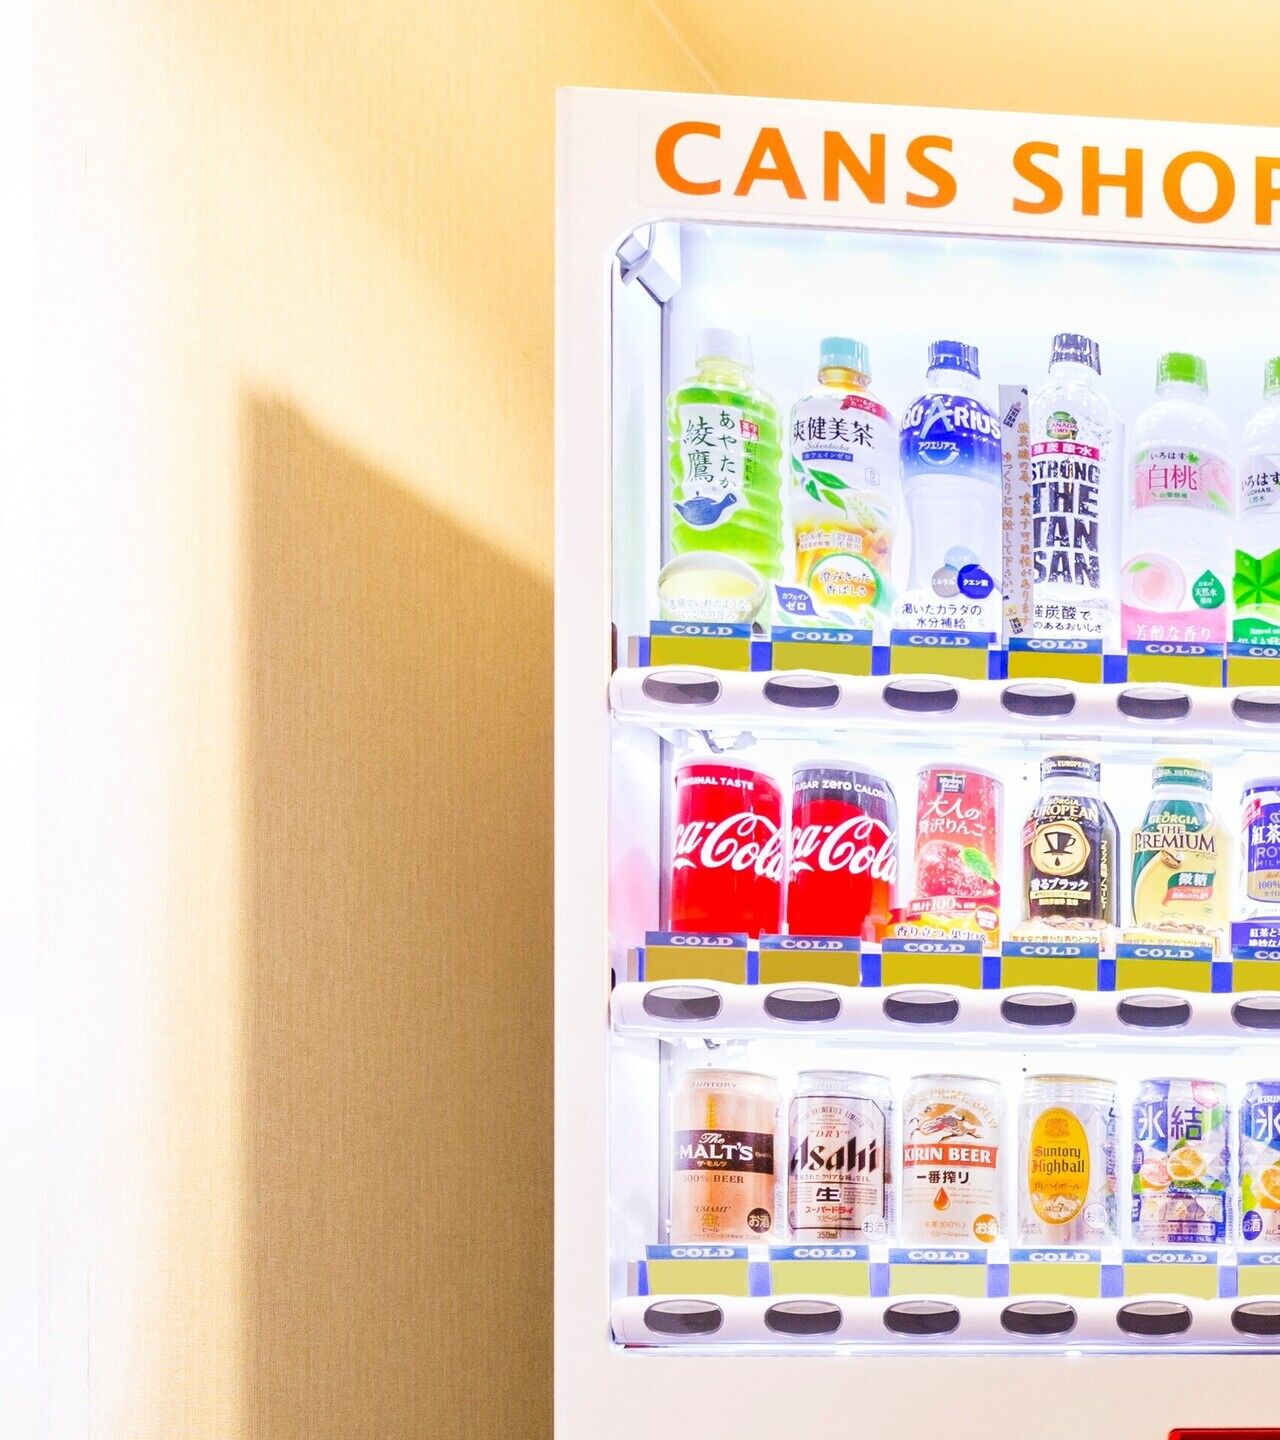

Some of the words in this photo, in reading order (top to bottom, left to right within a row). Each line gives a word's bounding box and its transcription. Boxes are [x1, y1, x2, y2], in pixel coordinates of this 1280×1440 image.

[655, 120, 958, 209] CANS
[683, 416, 716, 483] 綾鷹
[718, 410, 737, 489] あやたか
[918, 441, 960, 451] アクエリアス
[1151, 452, 1186, 460] いろはす
[1031, 458, 1100, 484] STRONG
[1148, 464, 1199, 491] 白桃
[1032, 481, 1099, 518] THE
[1033, 516, 1099, 552] TAN
[1034, 551, 1100, 589] SAN
[781, 592, 809, 601] カフェイン
[1195, 587, 1218, 597] 天然水
[785, 600, 808, 611] ゼロ
[916, 616, 967, 630] 水分補給
[670, 625, 734, 636] COLD
[791, 631, 854, 642] COLD
[1136, 623, 1212, 643] 芳醇な香り
[909, 635, 970, 646] COLD
[1026, 639, 1088, 650] COLD
[1145, 644, 1206, 654] COLD
[720, 777, 755, 791] TASTE
[821, 779, 853, 791] zero
[926, 798, 982, 820] 大人の
[1150, 812, 1200, 825] GEORGIA
[1159, 825, 1184, 835] THE
[1135, 833, 1216, 852] PREMIUM
[1030, 878, 1089, 891] 香るブラック
[1178, 872, 1208, 887] 微糖
[670, 935, 734, 946] COLD
[780, 939, 844, 950] COLD
[903, 942, 966, 952] COLD
[1020, 945, 1081, 955] COLD
[1134, 948, 1195, 958] COLD
[1138, 1105, 1203, 1141] 氷結
[700, 1132, 726, 1144] The
[679, 1141, 754, 1162] MALT'S
[790, 1135, 878, 1173] Asahi
[904, 1146, 943, 1162] KIRIN
[950, 1148, 992, 1164] BEER
[1034, 1145, 1081, 1163] Suntory
[1032, 1158, 1085, 1177] Highball
[713, 1174, 745, 1185] BEER
[916, 1170, 970, 1185] 一番搾り
[816, 1186, 841, 1202] 生
[804, 1206, 854, 1214] スーパードライ
[748, 1214, 771, 1229] お酒
[670, 1247, 735, 1258] COLD
[794, 1248, 857, 1259] COLD
[907, 1251, 970, 1261] COLD
[1029, 1252, 1091, 1262] COLD
[1146, 1253, 1208, 1263] COLD
